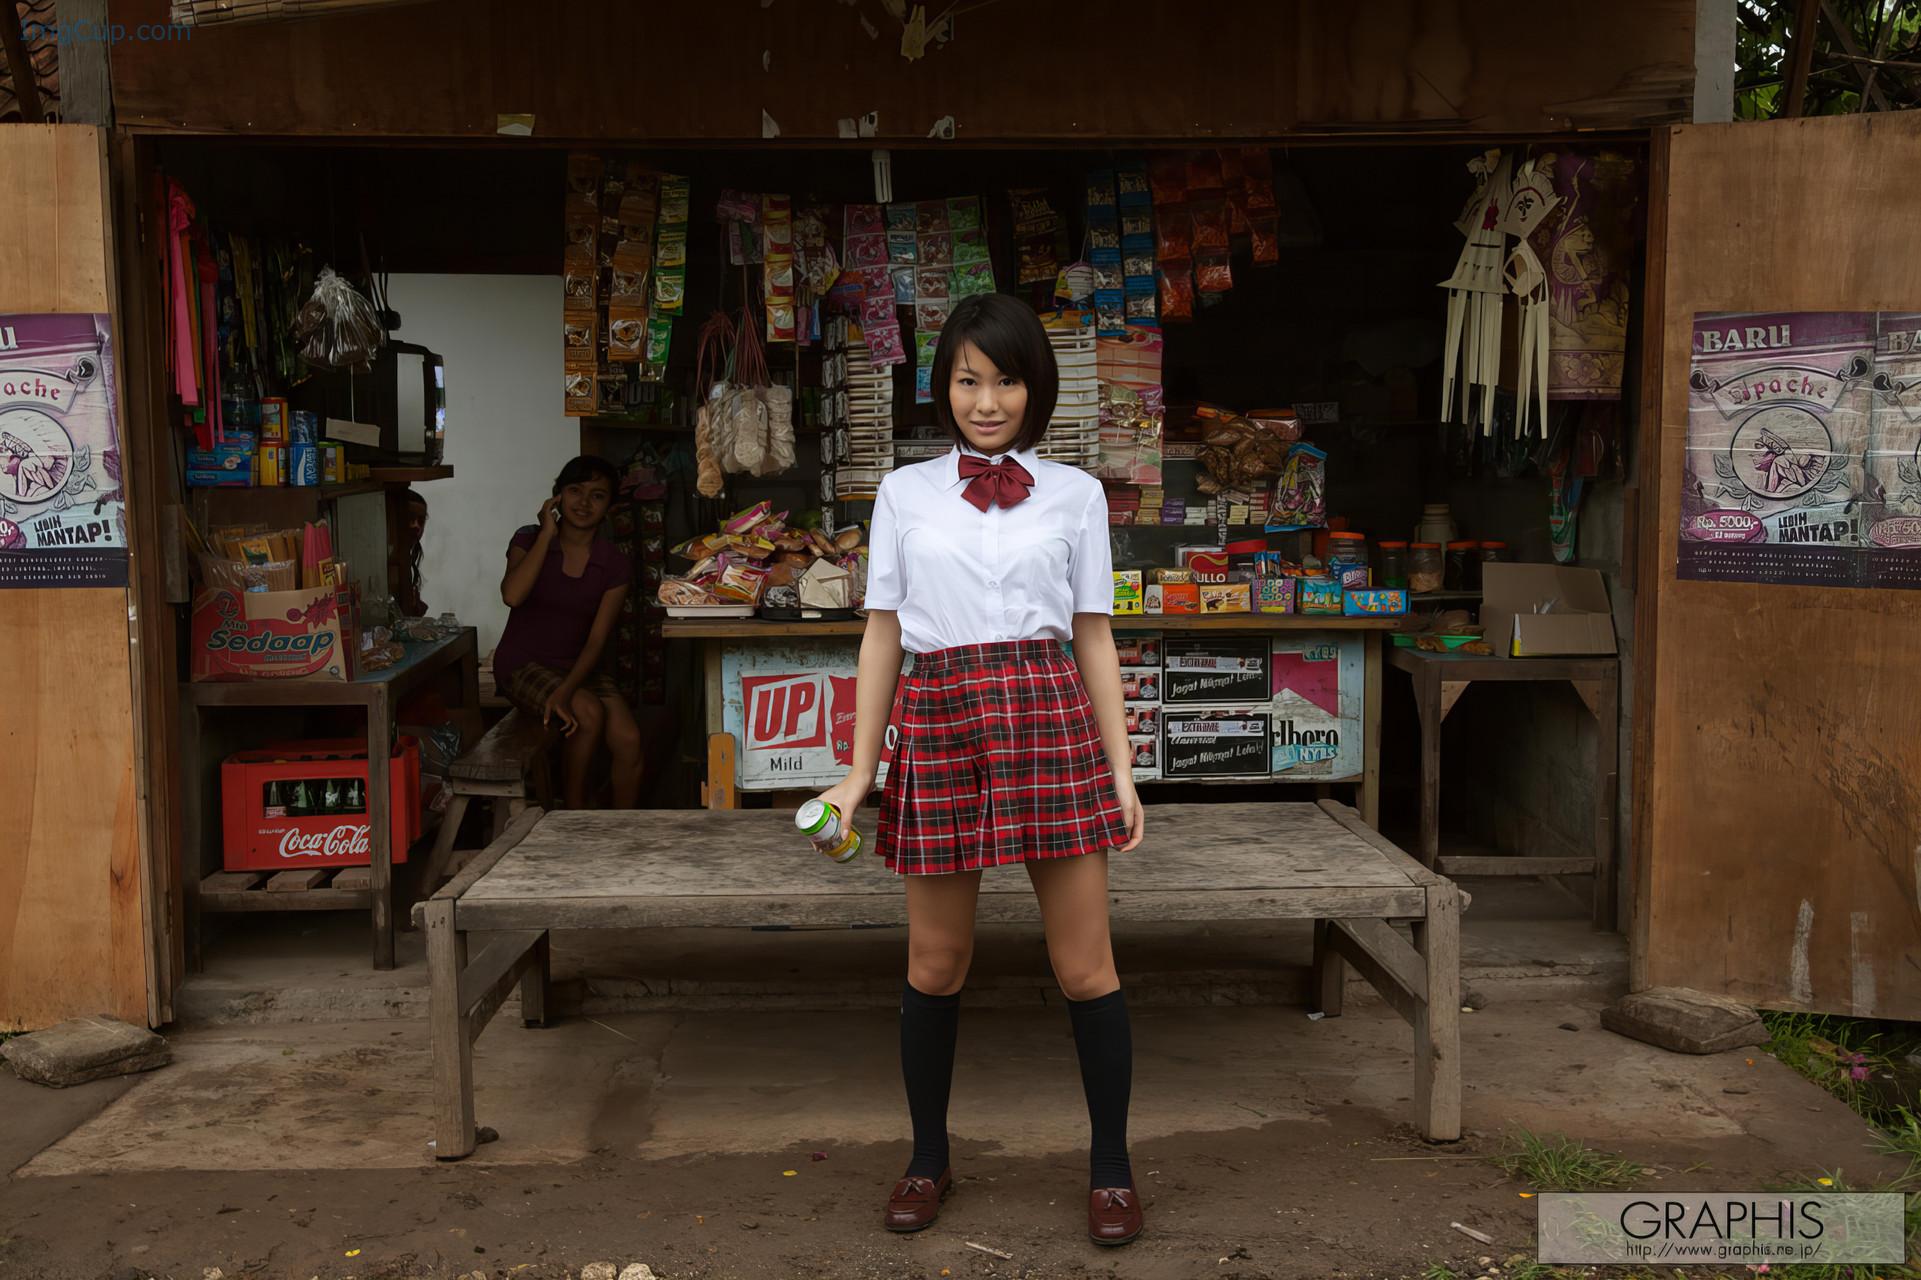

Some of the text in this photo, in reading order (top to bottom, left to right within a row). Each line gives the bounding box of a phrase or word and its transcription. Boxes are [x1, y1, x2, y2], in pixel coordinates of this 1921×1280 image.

[1702, 325, 1791, 352] BARU
[36, 519, 112, 546] MANTAP!
[1778, 519, 1859, 543] MANTAP!
[207, 629, 335, 656] Sedaap
[1170, 680, 1197, 698] Jagat
[753, 681, 817, 742] UP
[769, 755, 803, 771] Mild
[1170, 755, 1197, 772] Jagat
[278, 824, 371, 858] Coca-Cola
